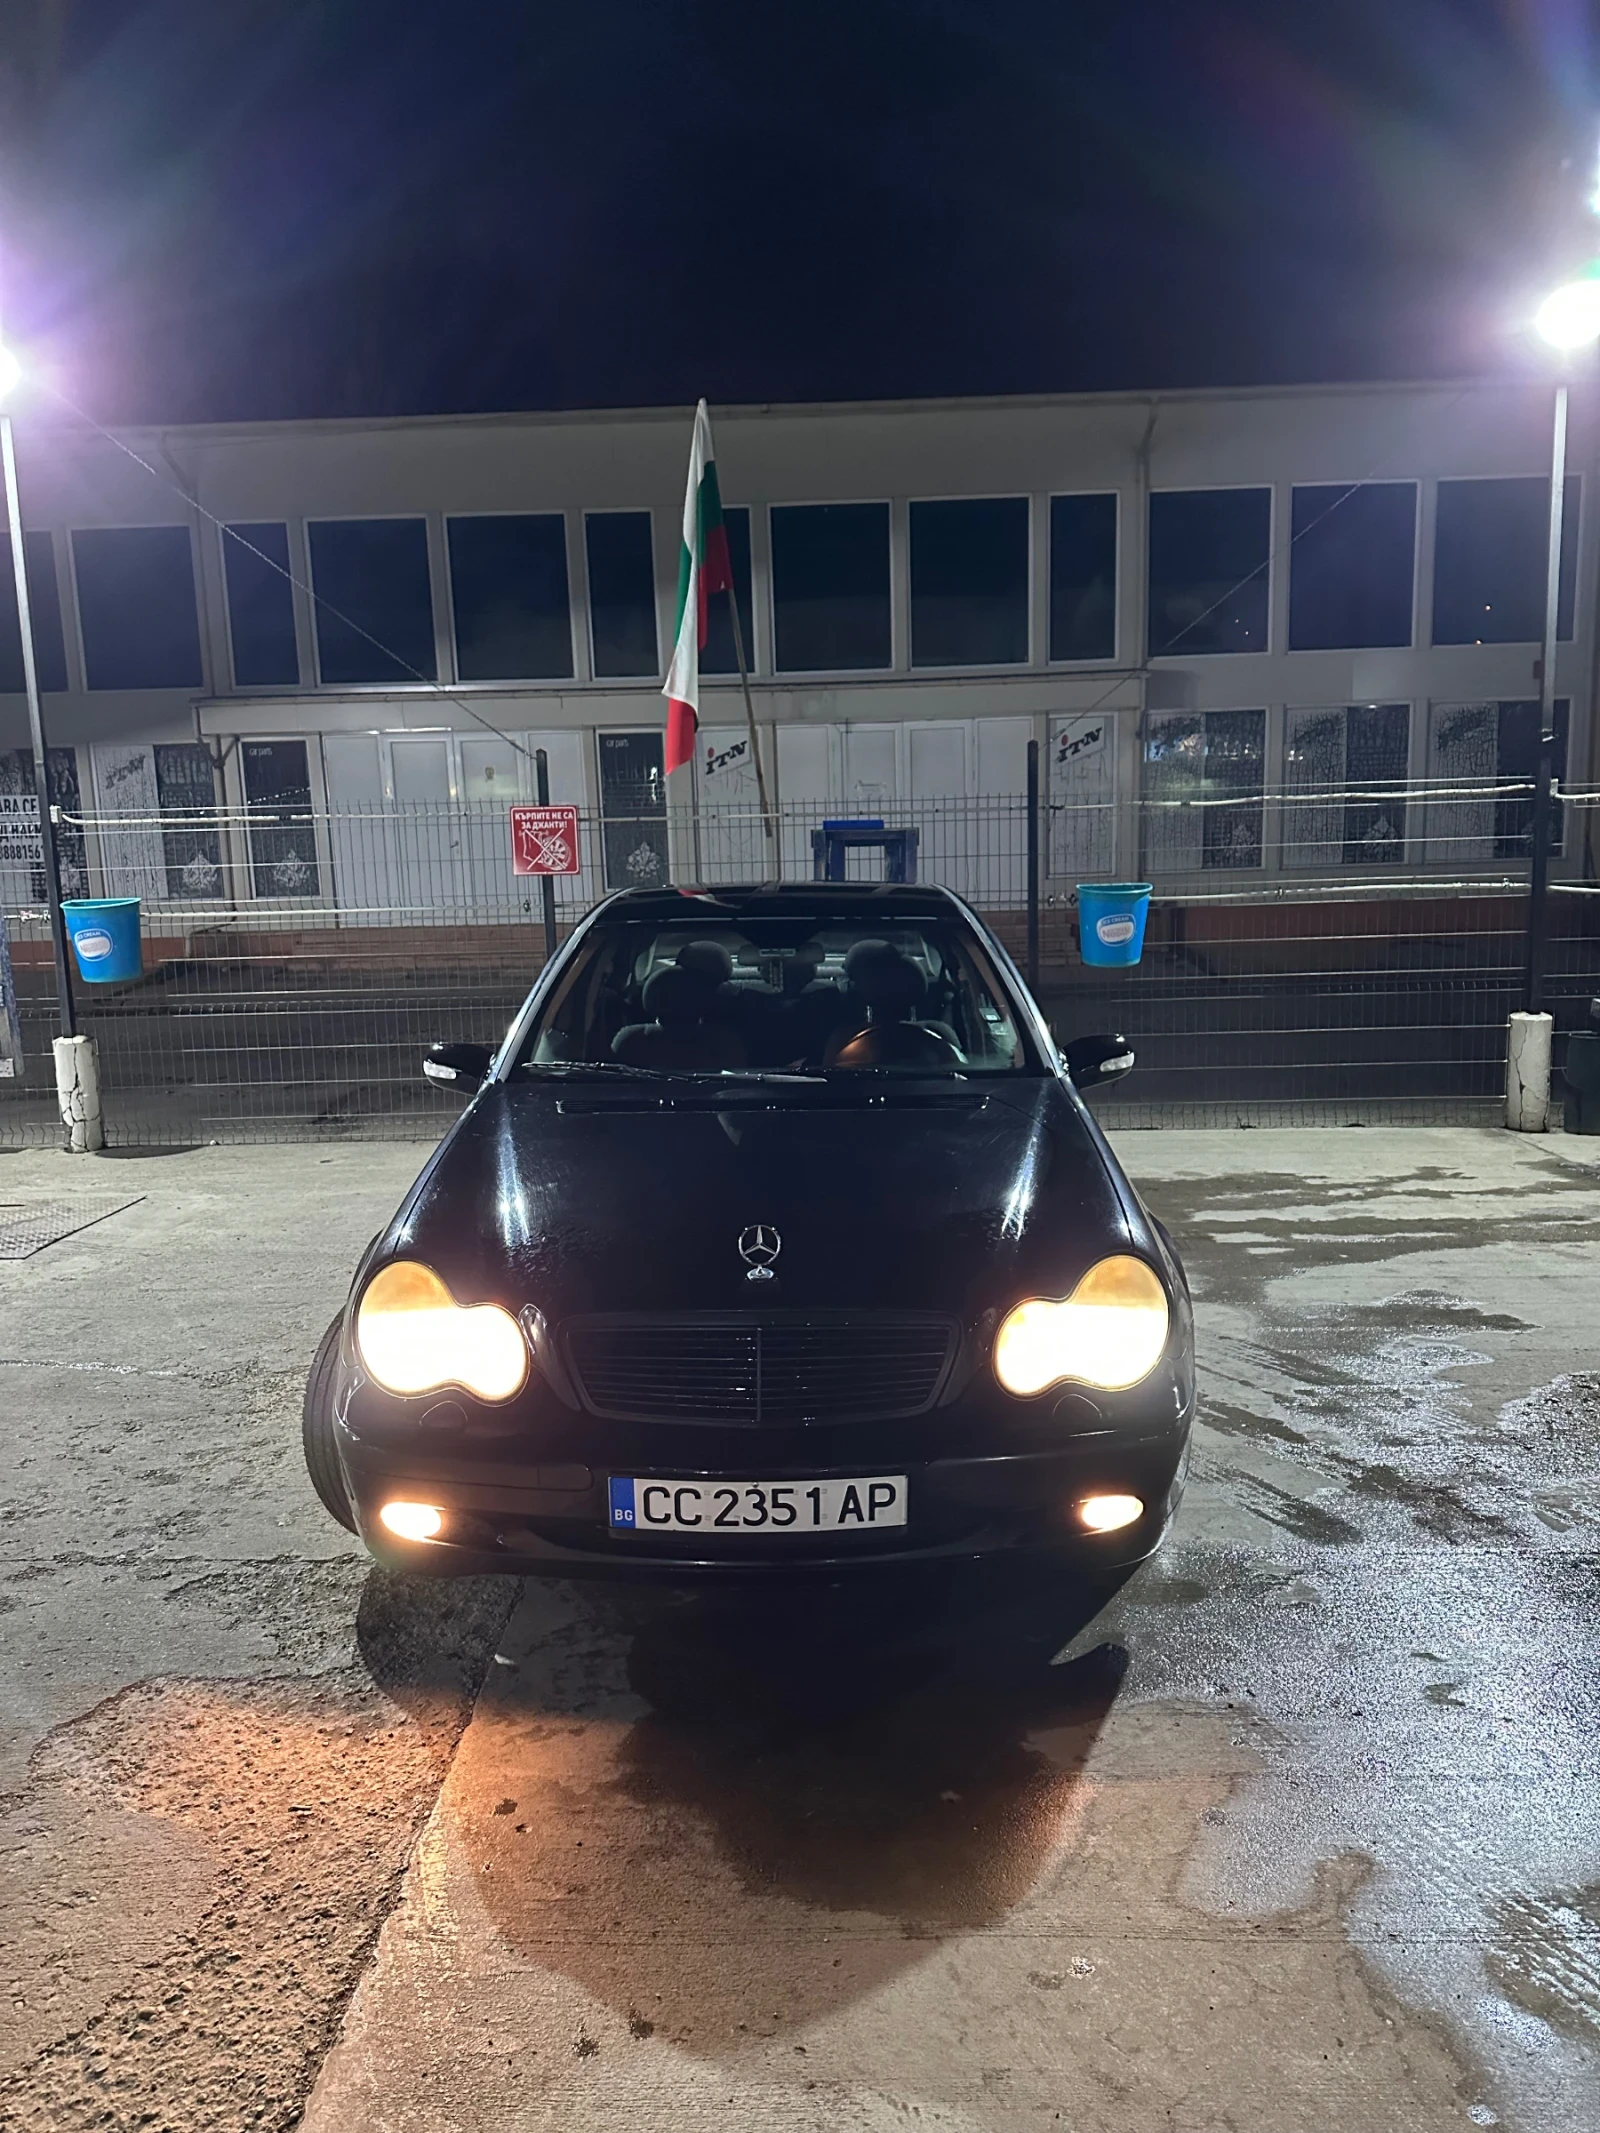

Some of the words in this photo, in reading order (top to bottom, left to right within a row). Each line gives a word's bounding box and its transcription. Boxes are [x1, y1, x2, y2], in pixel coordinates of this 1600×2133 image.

[515, 812, 550, 820] КЪРПИТЕ
[551, 812, 562, 820] НЕ
[563, 811, 573, 819] СА
[521, 821, 531, 829] ЗА
[532, 821, 568, 830] ДЖАНТИ!
[643, 1486, 702, 1526] CC
[713, 1487, 821, 1526] 2351
[837, 1483, 897, 1524] AP
[615, 1508, 633, 1521] BG
